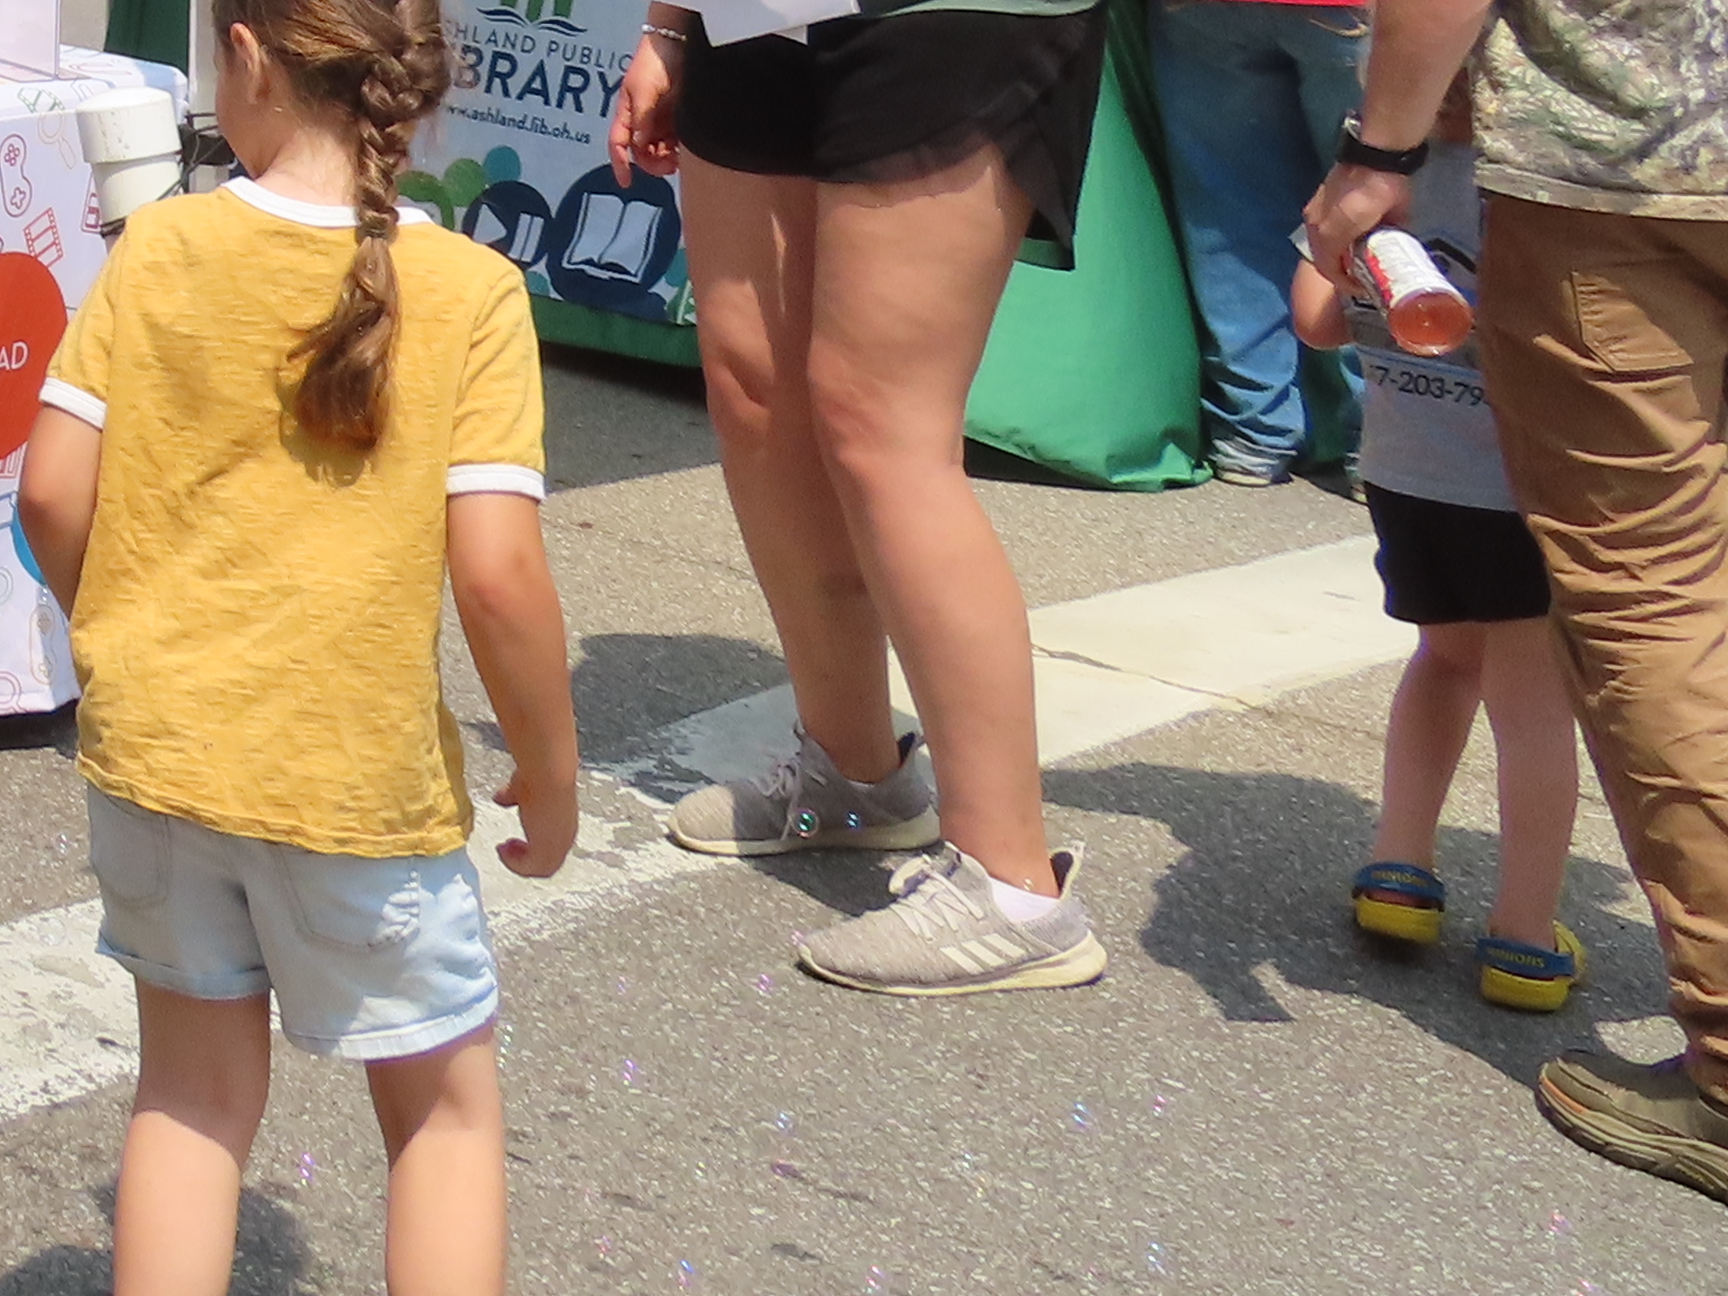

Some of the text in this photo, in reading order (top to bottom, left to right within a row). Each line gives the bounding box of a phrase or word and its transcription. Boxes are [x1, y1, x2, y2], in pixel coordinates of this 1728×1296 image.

[446, 20, 634, 73] HLAND PUBLIC
[452, 44, 625, 119] BRARY
